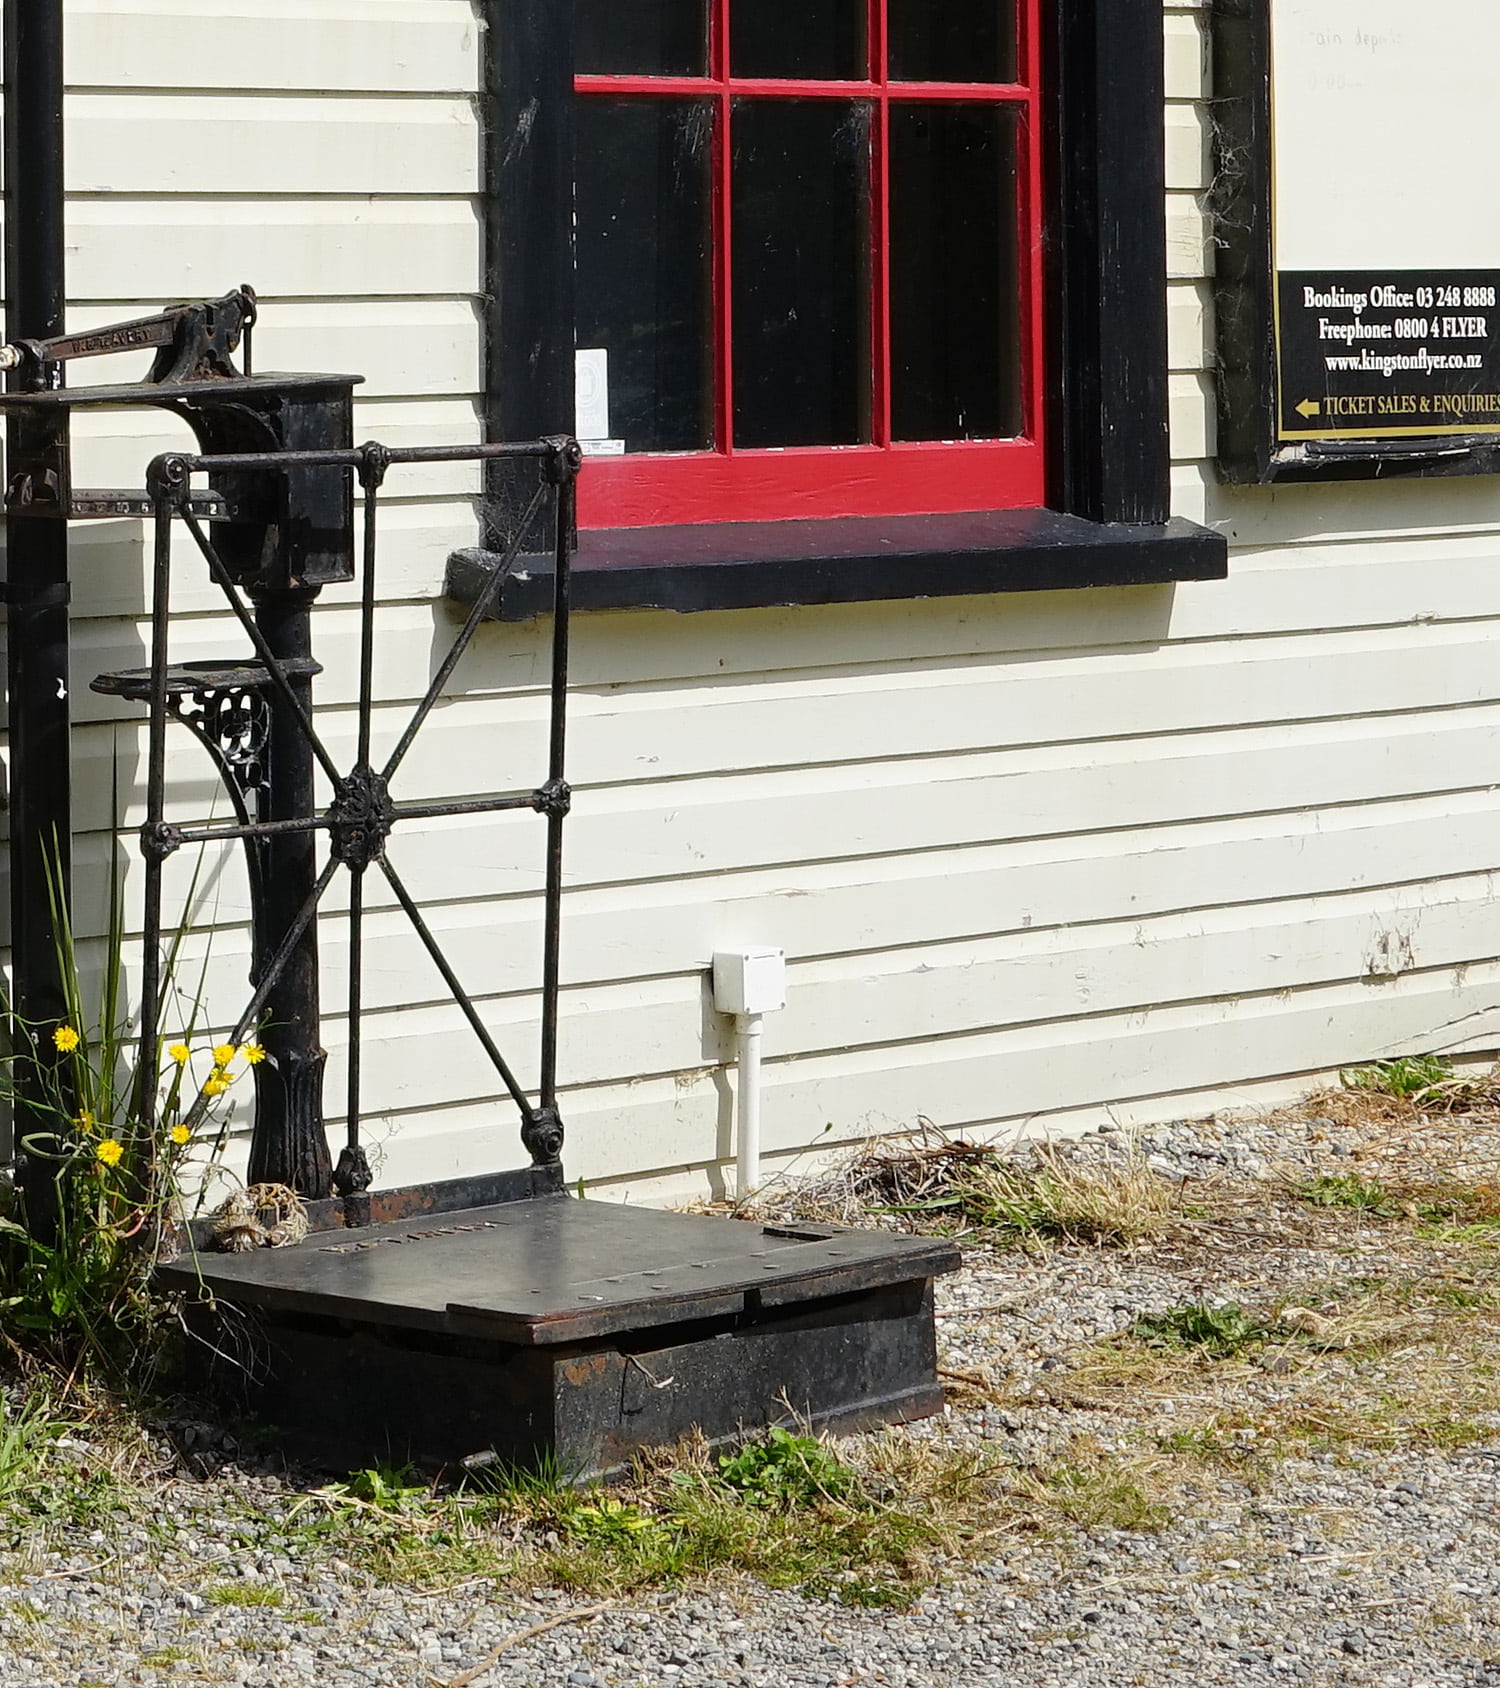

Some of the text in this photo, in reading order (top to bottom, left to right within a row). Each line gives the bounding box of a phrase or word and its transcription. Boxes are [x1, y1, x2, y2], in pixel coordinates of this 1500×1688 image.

[1303, 284, 1496, 314] Bookings Office: 03 248 8888
[1318, 316, 1488, 345] Freephone: 0800 4 FLYER
[1325, 347, 1482, 377] www.kingstonflyer.co.nz
[1323, 396, 1375, 416] TICKET
[1377, 395, 1417, 415] SALES
[1419, 396, 1431, 413] &
